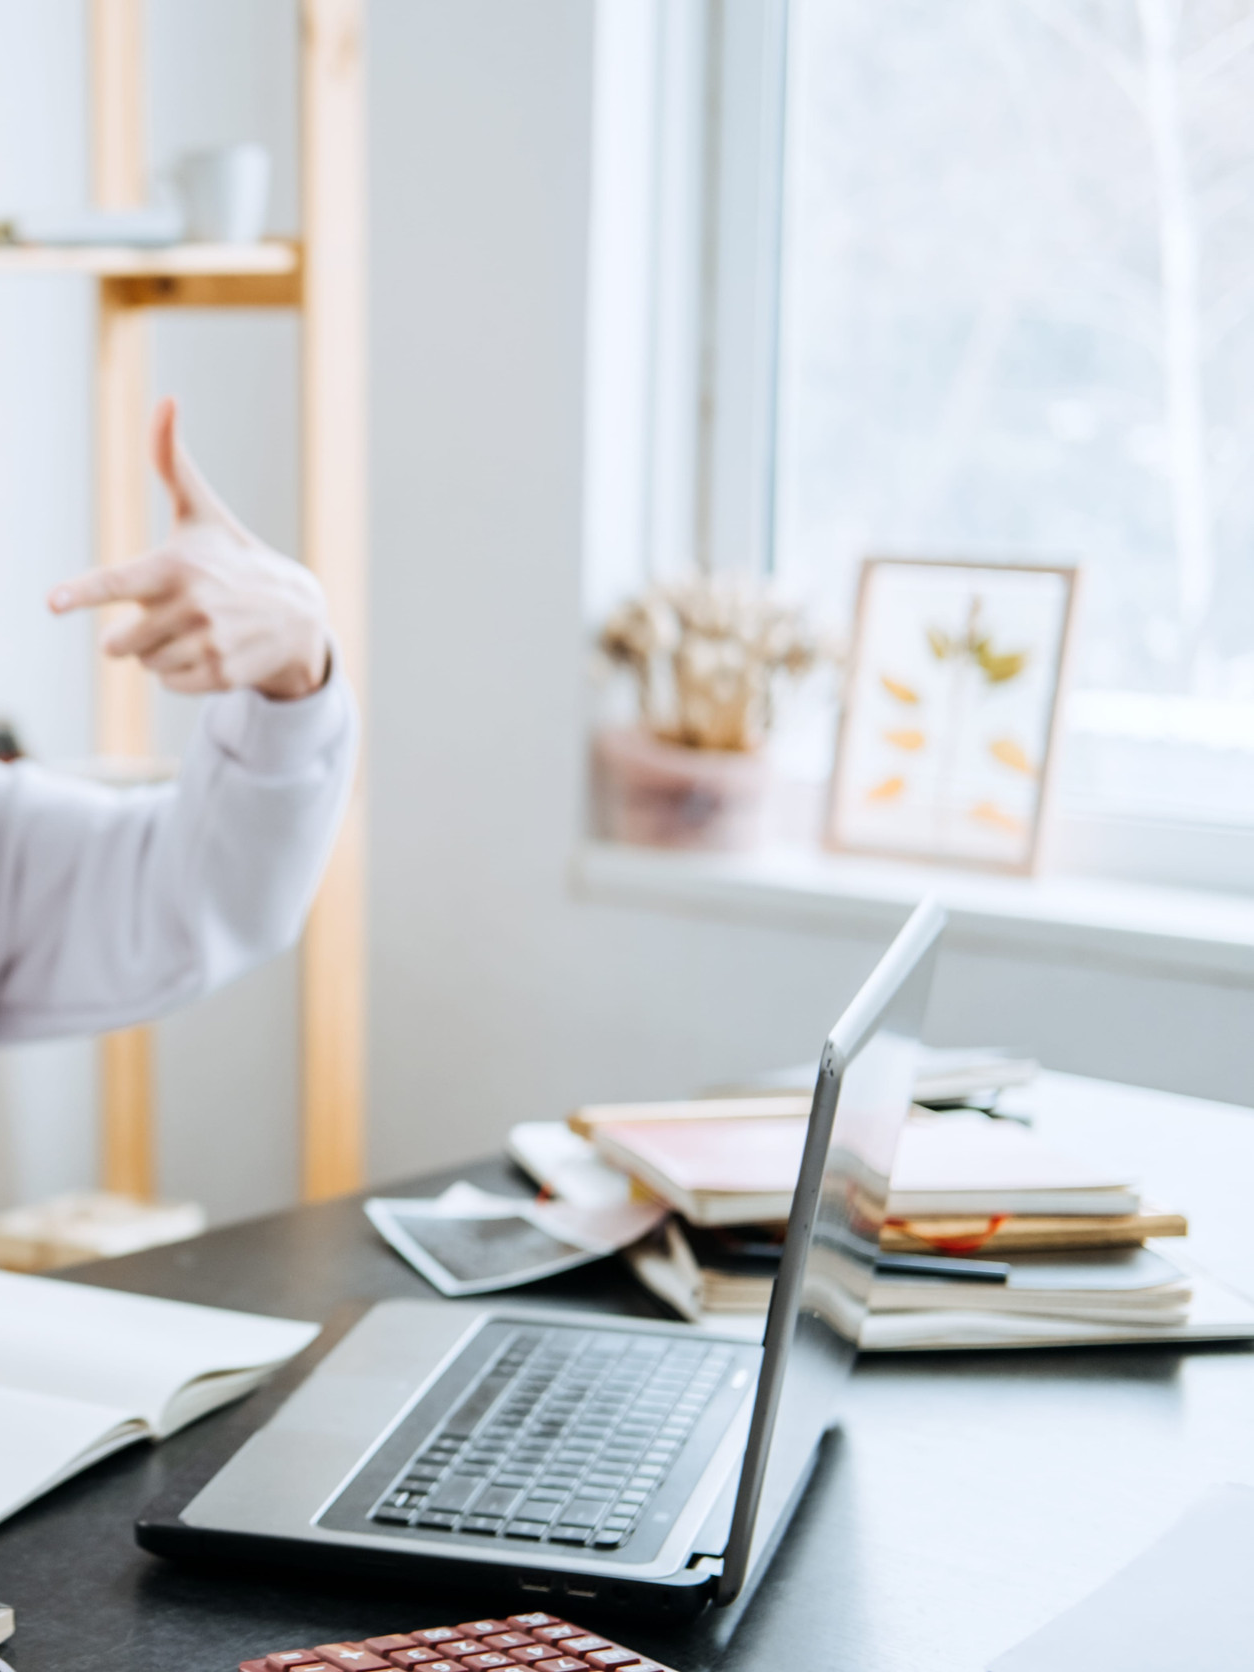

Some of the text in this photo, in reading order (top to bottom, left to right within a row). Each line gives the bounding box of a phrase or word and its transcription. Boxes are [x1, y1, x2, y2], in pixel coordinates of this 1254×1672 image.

[452, 1642, 476, 1652] 2
[407, 1649, 427, 1659] 3
[557, 1659, 575, 1668] 7
